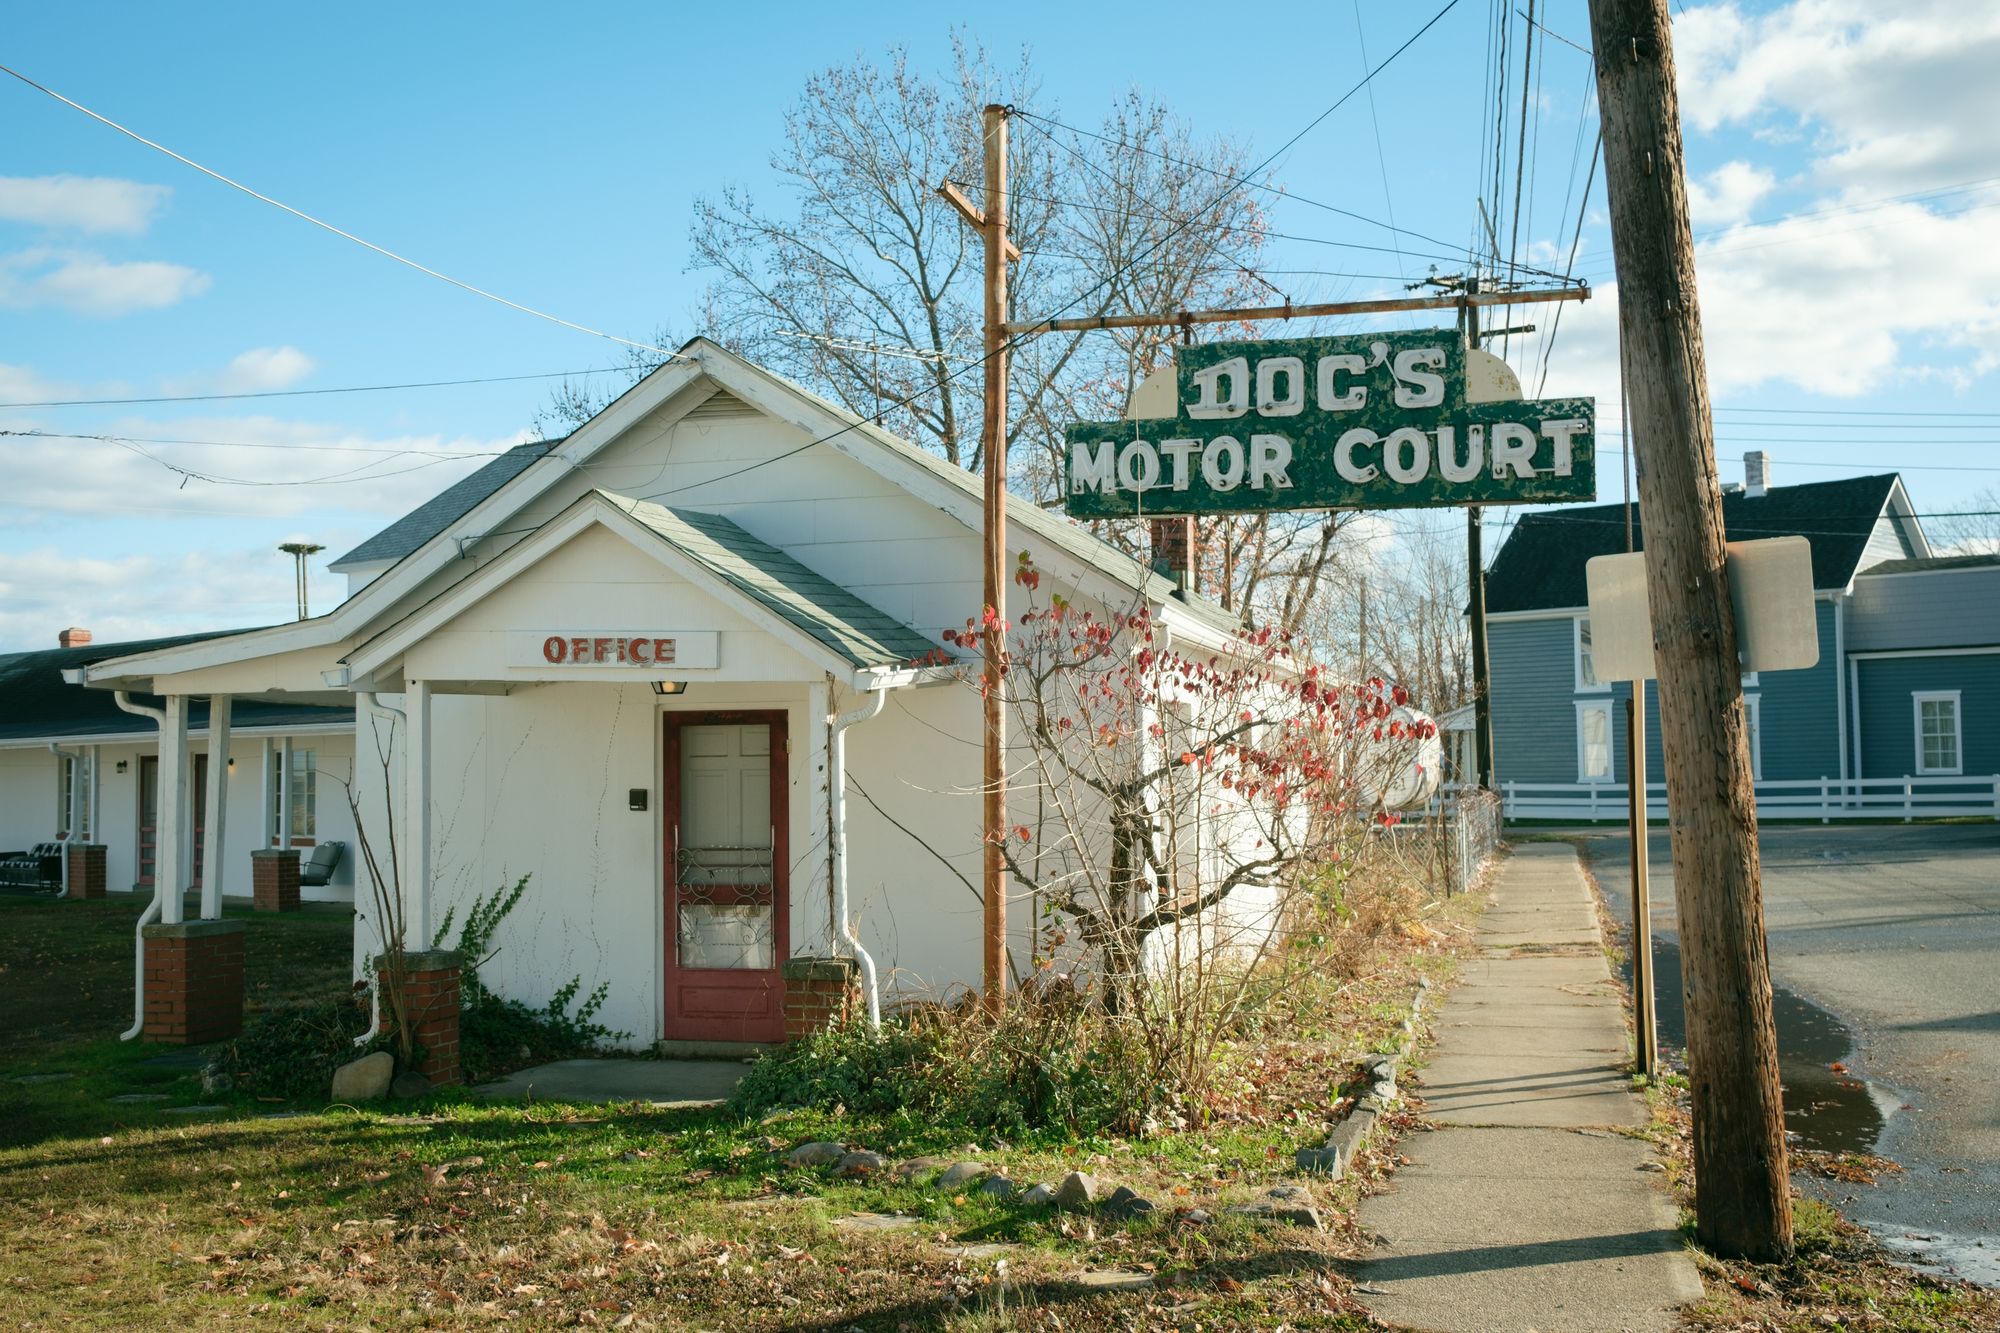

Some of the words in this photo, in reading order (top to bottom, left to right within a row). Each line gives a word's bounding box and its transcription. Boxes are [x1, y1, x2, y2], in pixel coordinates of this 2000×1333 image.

[1185, 341, 1446, 420] DOC'S
[1072, 434, 1294, 495] MOTOR
[1333, 419, 1588, 484] COURT
